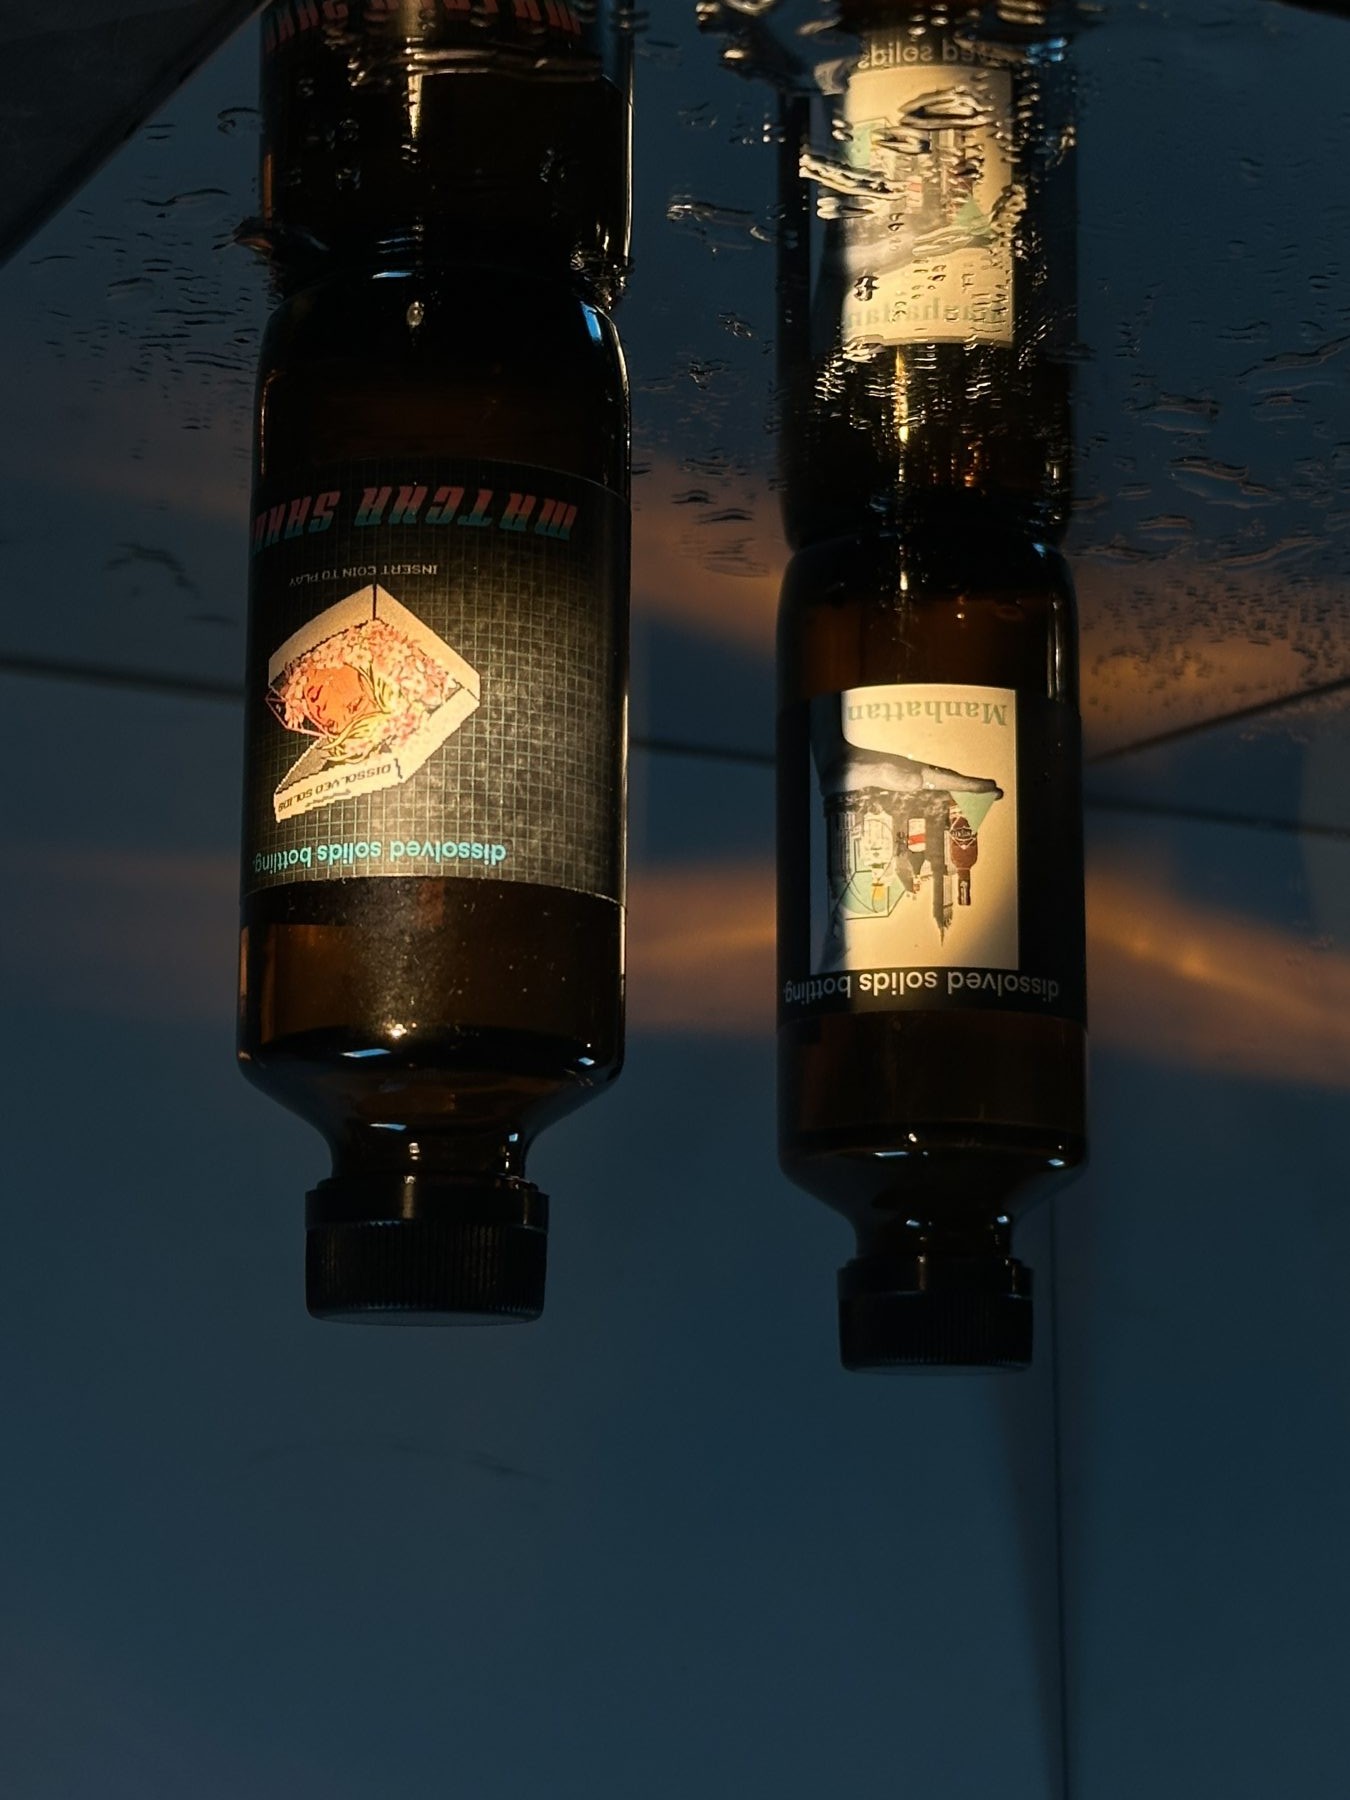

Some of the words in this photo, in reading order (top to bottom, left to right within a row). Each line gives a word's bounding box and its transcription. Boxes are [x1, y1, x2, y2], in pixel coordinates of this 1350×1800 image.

[354, 485, 578, 541] MATCHA
[289, 571, 319, 586] PLAY
[321, 570, 339, 580] TO
[343, 565, 377, 579] COIN
[380, 564, 438, 576] INSERT
[846, 701, 1007, 726] Manhattan
[315, 763, 392, 797] DISSOLVED
[277, 786, 314, 812] SOLIDS
[317, 842, 382, 867] solids
[389, 840, 506, 867] dissolved
[859, 971, 938, 997] solids
[948, 972, 1059, 1001] dissolved
